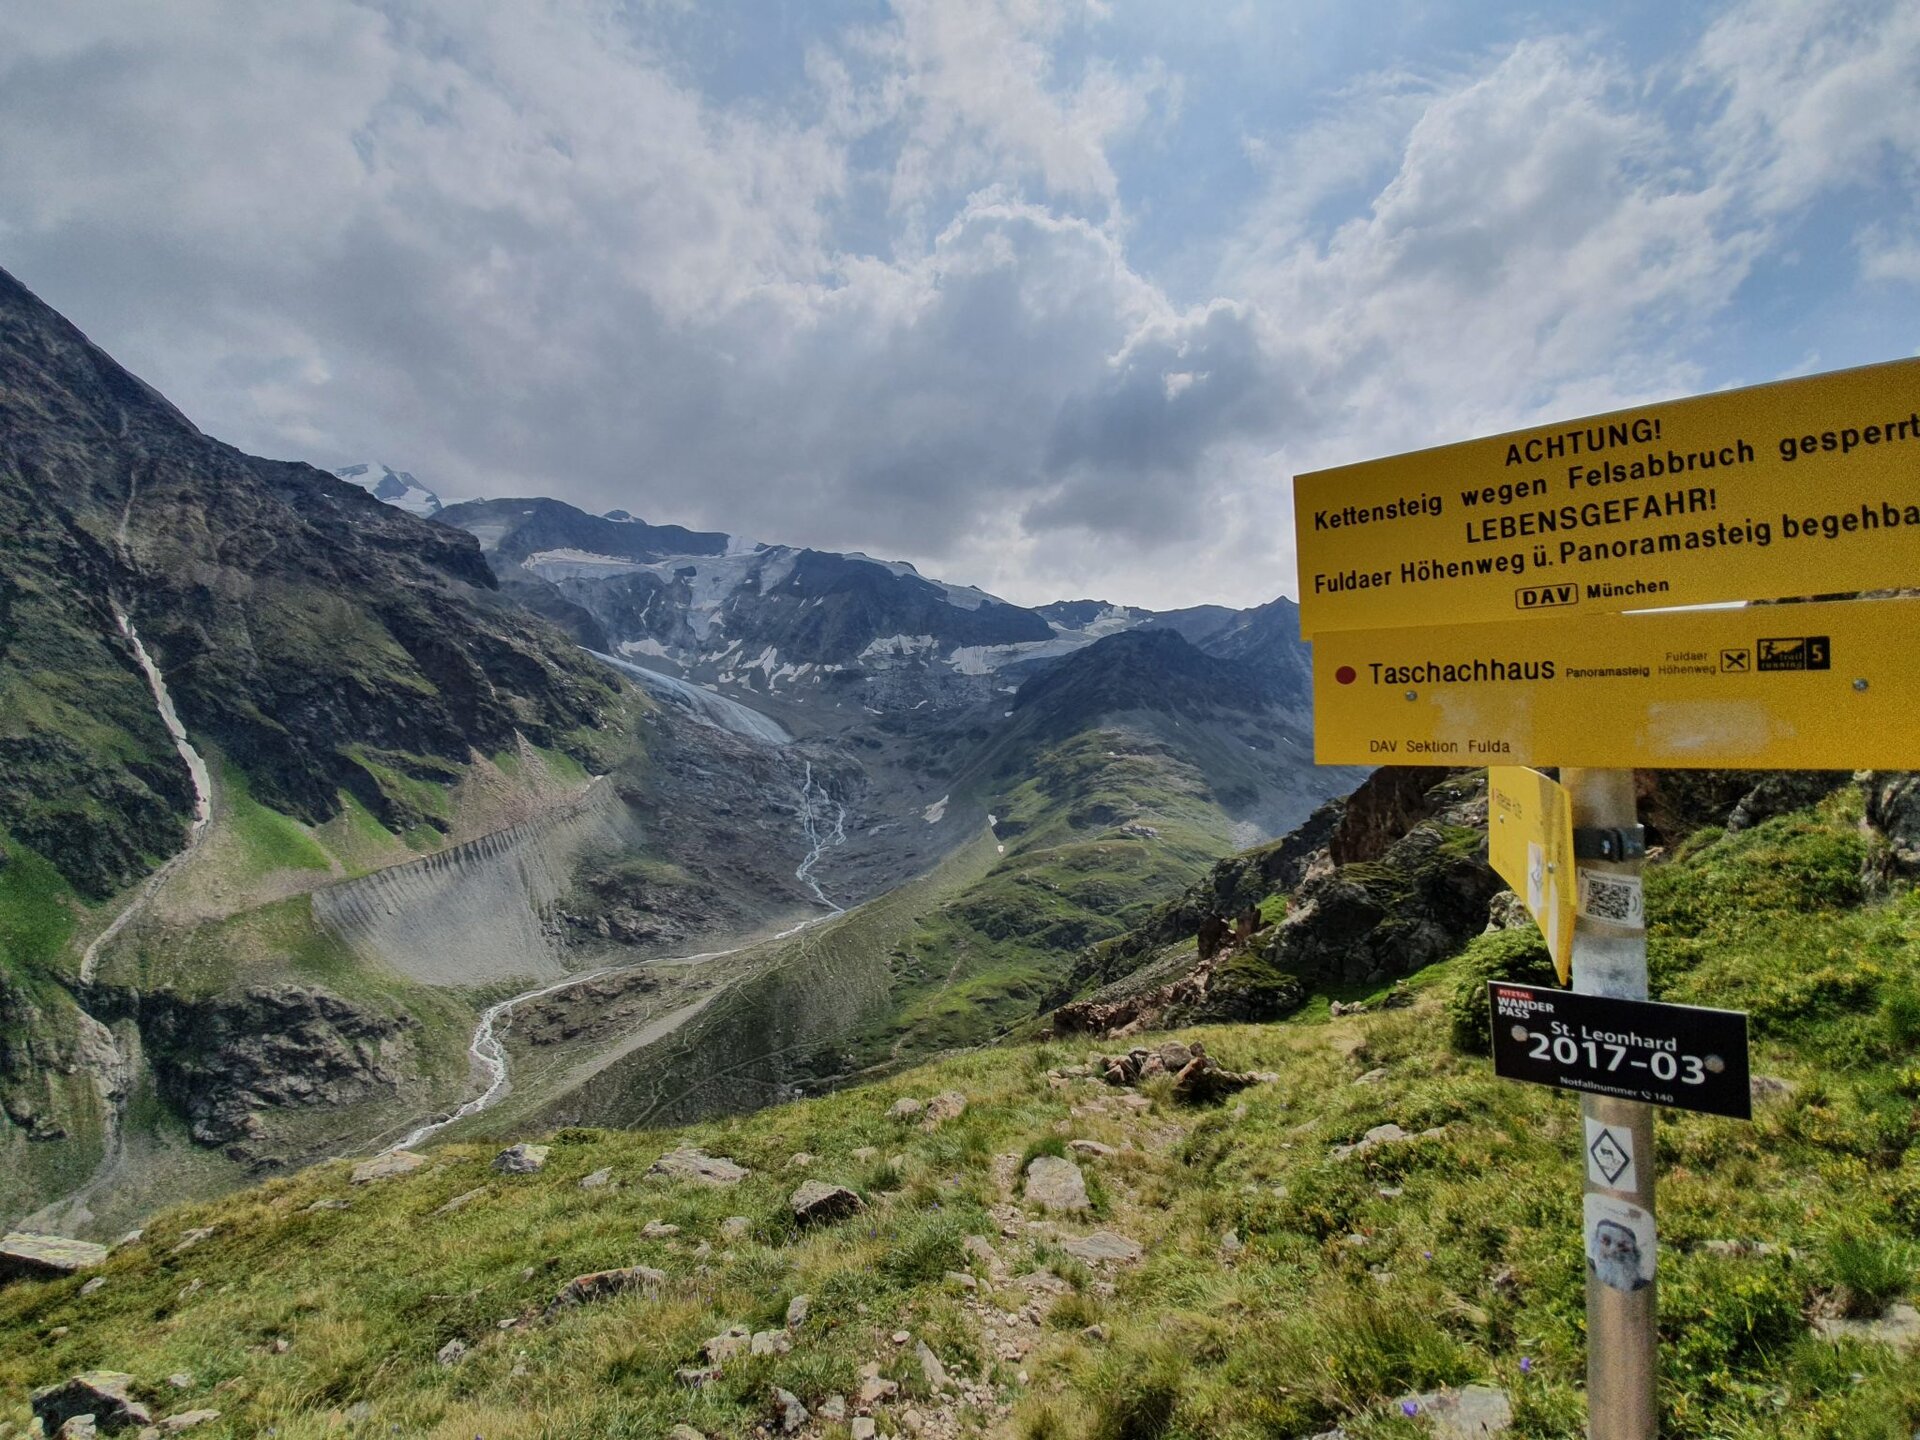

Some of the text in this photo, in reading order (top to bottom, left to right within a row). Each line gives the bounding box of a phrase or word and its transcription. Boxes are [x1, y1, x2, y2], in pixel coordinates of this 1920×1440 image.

[1505, 419, 1661, 466] ACHTUNG!
[1315, 493, 1442, 530] Kettensteig
[1461, 478, 1547, 506] wegen
[1568, 439, 1754, 489] Felsabbruch
[1466, 488, 1716, 543] LEBENSGEFAHR!
[1315, 502, 1920, 593] Fuldaer Höhenweg ü. Panoramasteig begehba
[1522, 579, 1669, 606] DAV München
[1665, 652, 1708, 661] Fuldaer
[1811, 644, 1823, 662] 5
[1368, 659, 1650, 685] Taschachhaus Panoramasteig
[1658, 664, 1717, 675] Höhenweg
[1370, 740, 1511, 753] DAV Sektion Fulda
[1497, 996, 1555, 1013] WANDER
[1498, 1005, 1530, 1019] PASS
[1551, 1021, 1677, 1051] St. Leonhard
[1528, 1033, 1706, 1085] 2017-03
[1560, 1076, 1674, 1103] Notfallnummer 140
